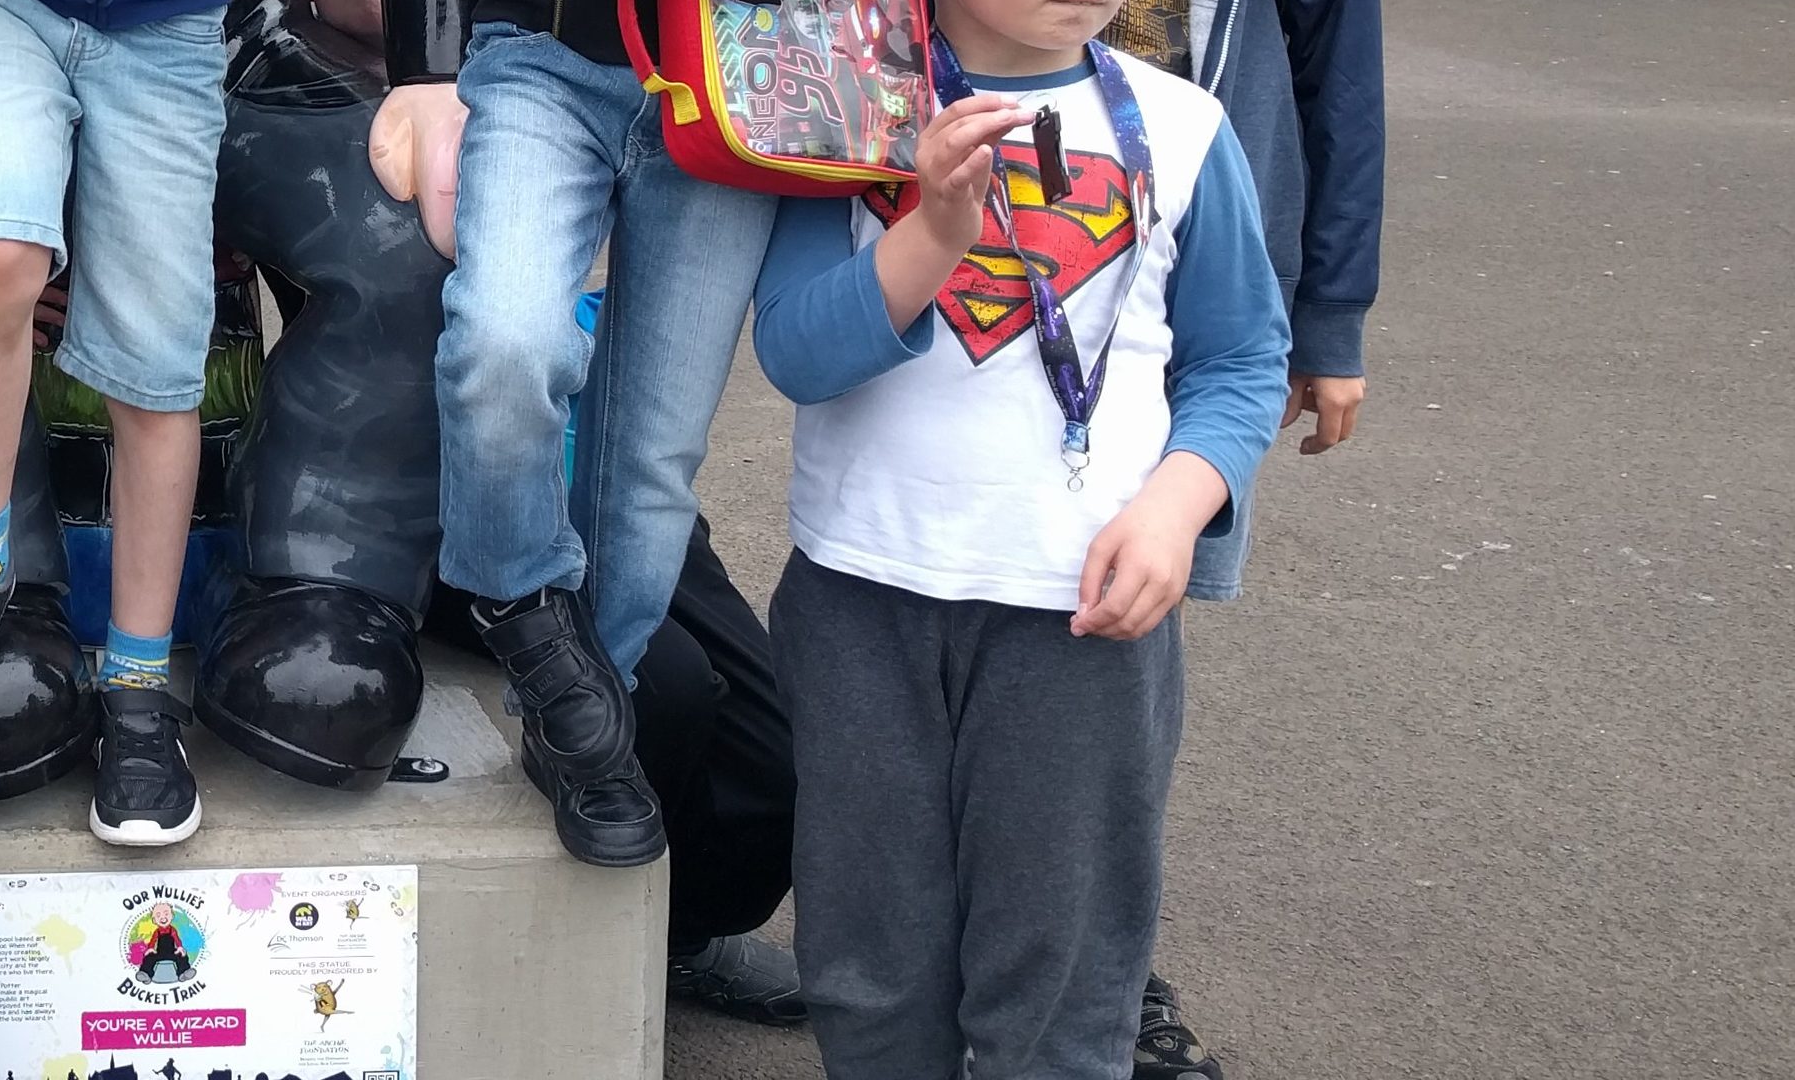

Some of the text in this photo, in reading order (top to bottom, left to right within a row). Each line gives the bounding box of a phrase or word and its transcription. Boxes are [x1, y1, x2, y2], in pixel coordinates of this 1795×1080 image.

[778, 44, 846, 127] 95
[122, 884, 205, 911] OOR WULLIE'S
[116, 977, 207, 1005] BUCKET TRAIL
[86, 1016, 240, 1032] YOU'RE A WIZARD
[133, 1032, 193, 1045] WULLIE
